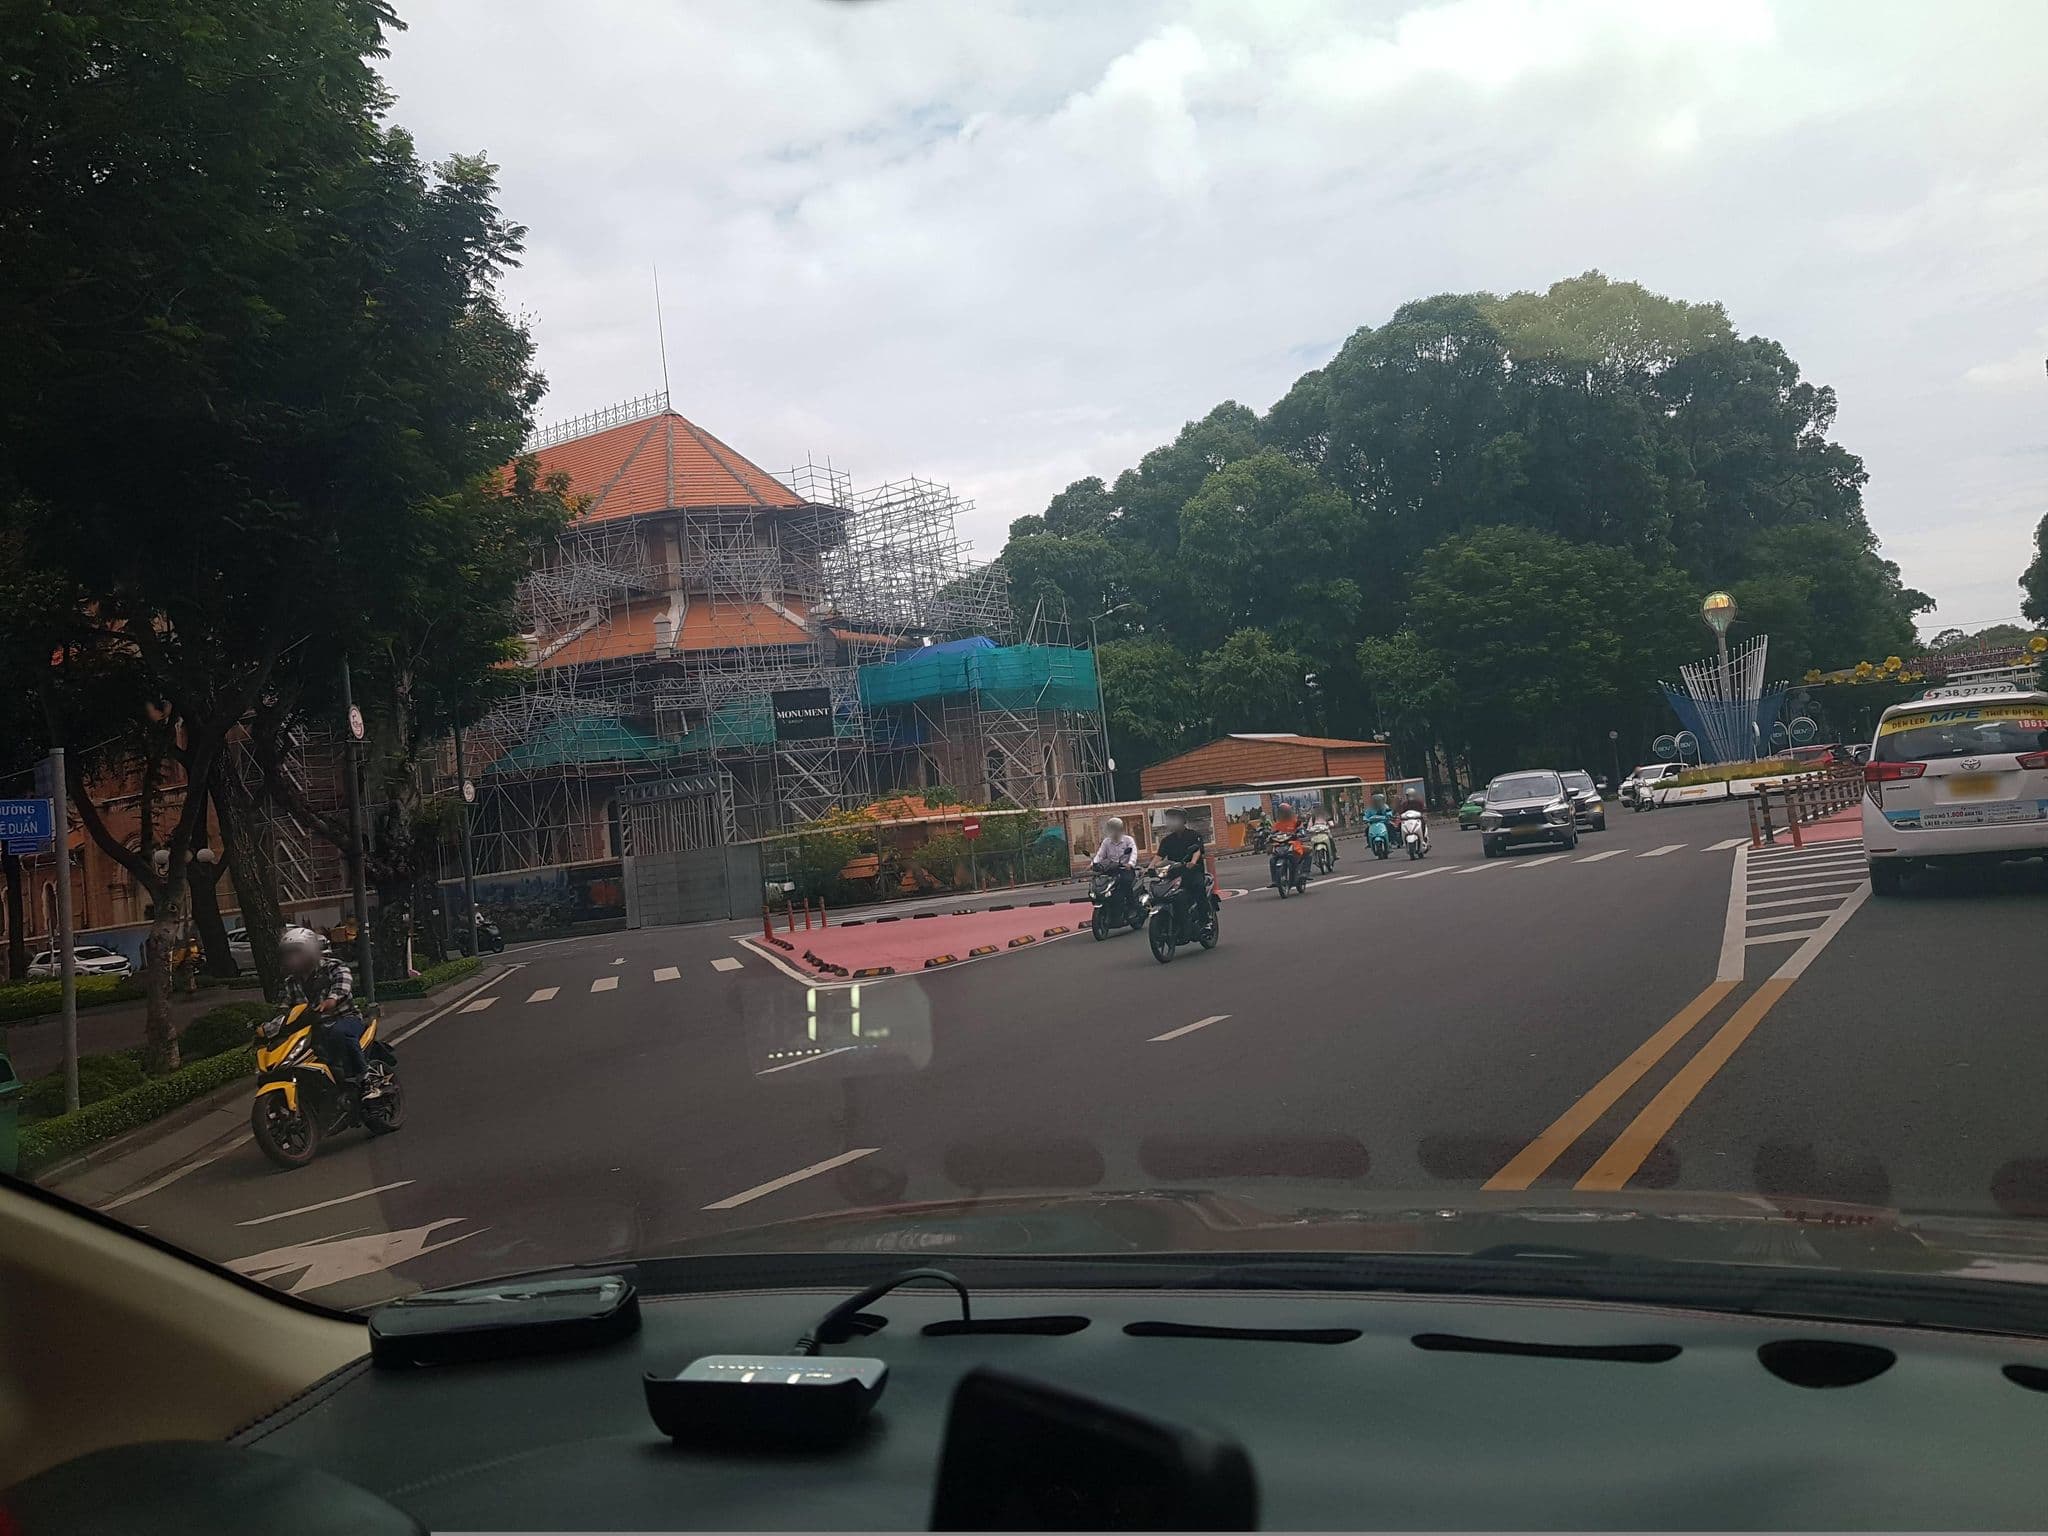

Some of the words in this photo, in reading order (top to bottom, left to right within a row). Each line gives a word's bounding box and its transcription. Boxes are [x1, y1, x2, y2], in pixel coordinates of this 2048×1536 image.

[1945, 689, 1960, 697] 38
[1963, 687, 1978, 695] 27
[1981, 686, 1996, 694] 27
[1999, 685, 2014, 693] 27
[777, 708, 829, 719] MONUMENT
[1930, 709, 1981, 723] MPE
[0, 804, 35, 815] ƯỜNG
